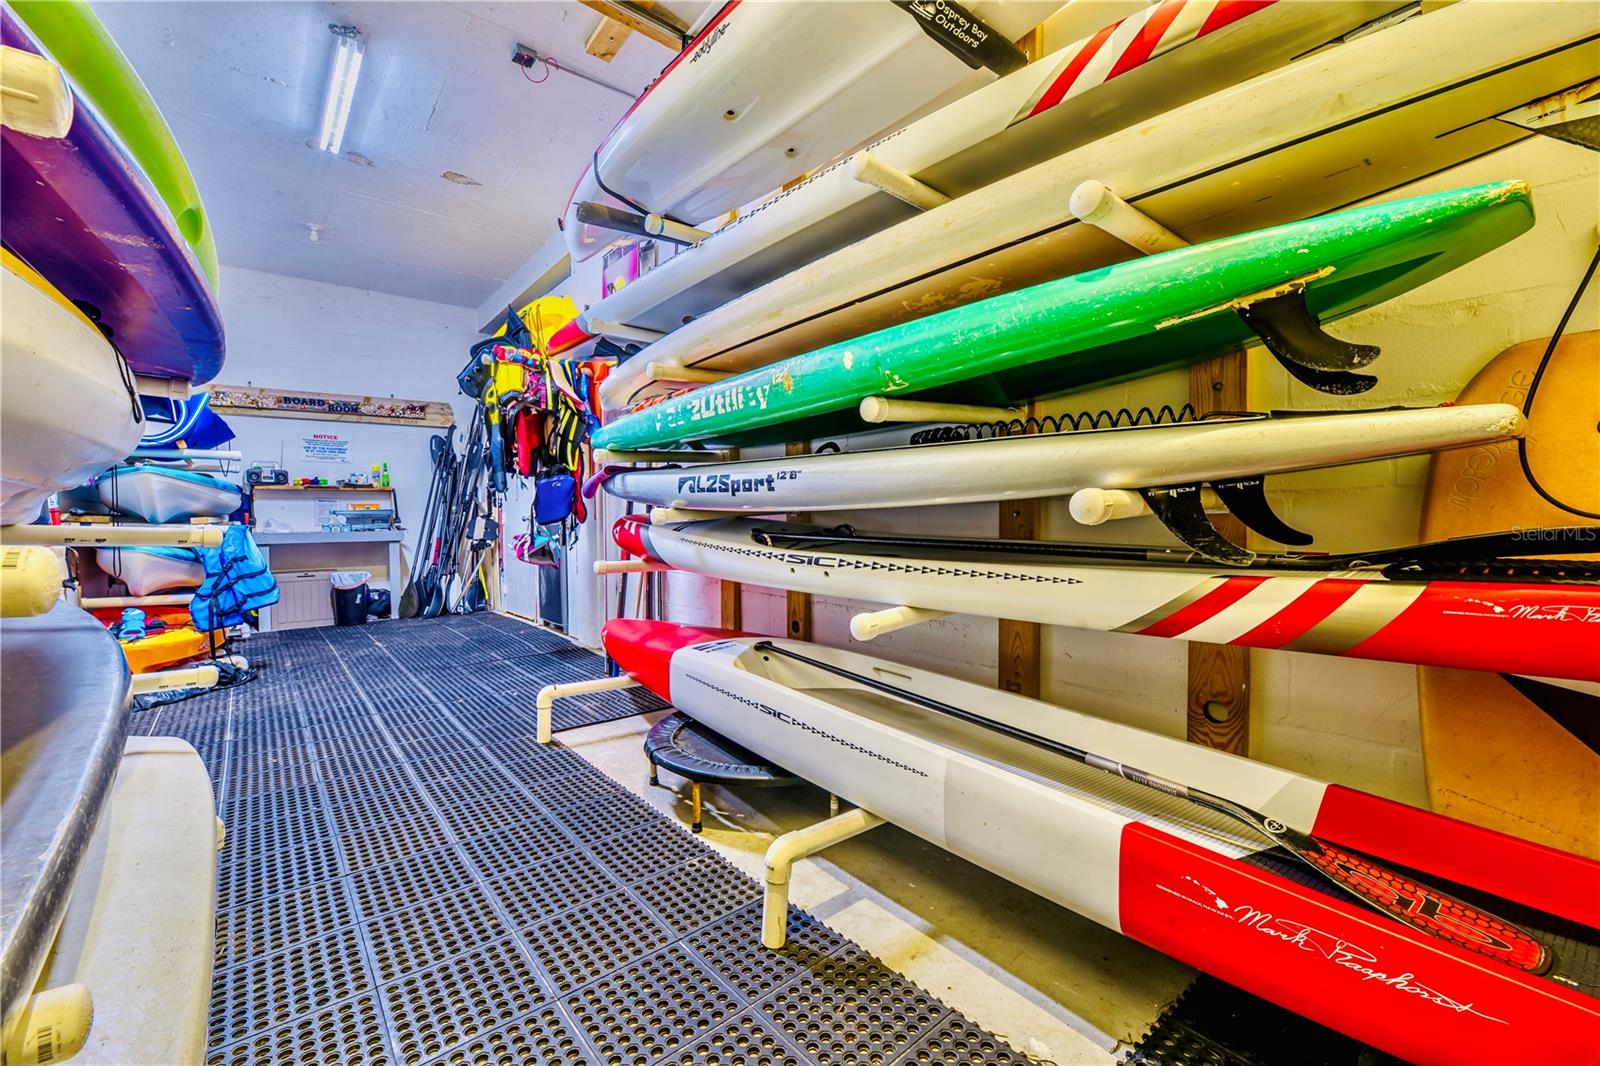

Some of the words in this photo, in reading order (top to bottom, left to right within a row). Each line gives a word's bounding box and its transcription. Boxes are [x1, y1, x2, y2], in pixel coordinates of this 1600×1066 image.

[935, 14, 980, 48] Outdoors
[936, 0, 970, 30] Osprey
[971, 24, 988, 42] Bay
[283, 396, 325, 407] BOARD
[328, 404, 359, 413] ROOM
[1233, 904, 1316, 952] Mark
